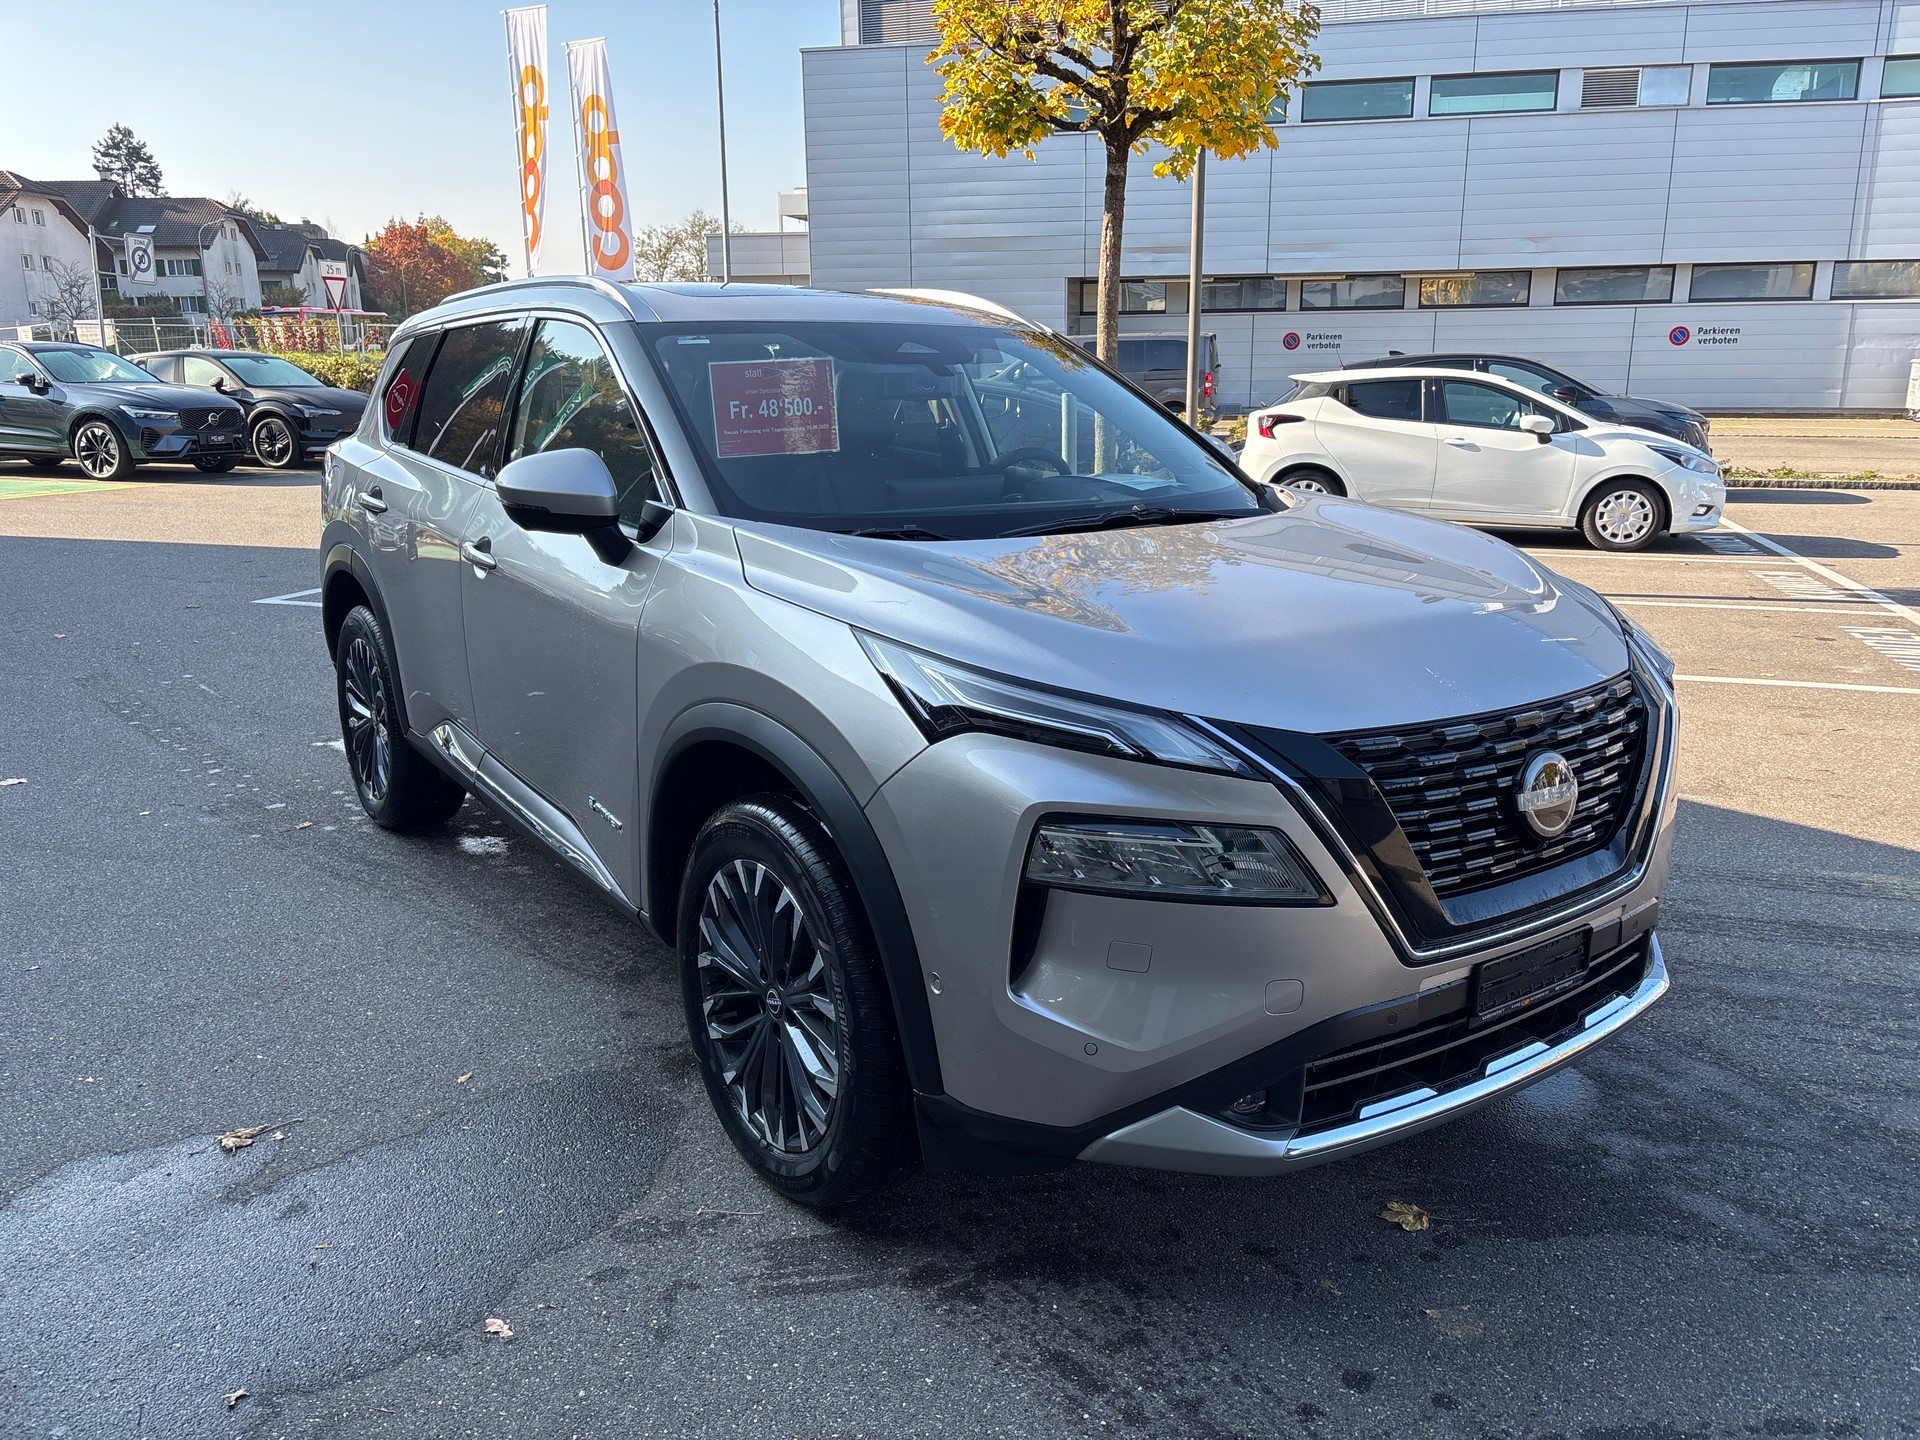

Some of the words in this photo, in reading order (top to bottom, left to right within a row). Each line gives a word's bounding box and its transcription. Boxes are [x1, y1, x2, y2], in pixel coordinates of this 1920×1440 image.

[582, 94, 629, 271] coop
[326, 264, 334, 275] 25
[335, 267, 342, 275] m
[1697, 326, 1741, 335] Parkieren
[1306, 332, 1343, 340] Parkieren
[1697, 336, 1738, 345] verboten
[744, 368, 763, 378] statt
[729, 400, 753, 420] Fr.
